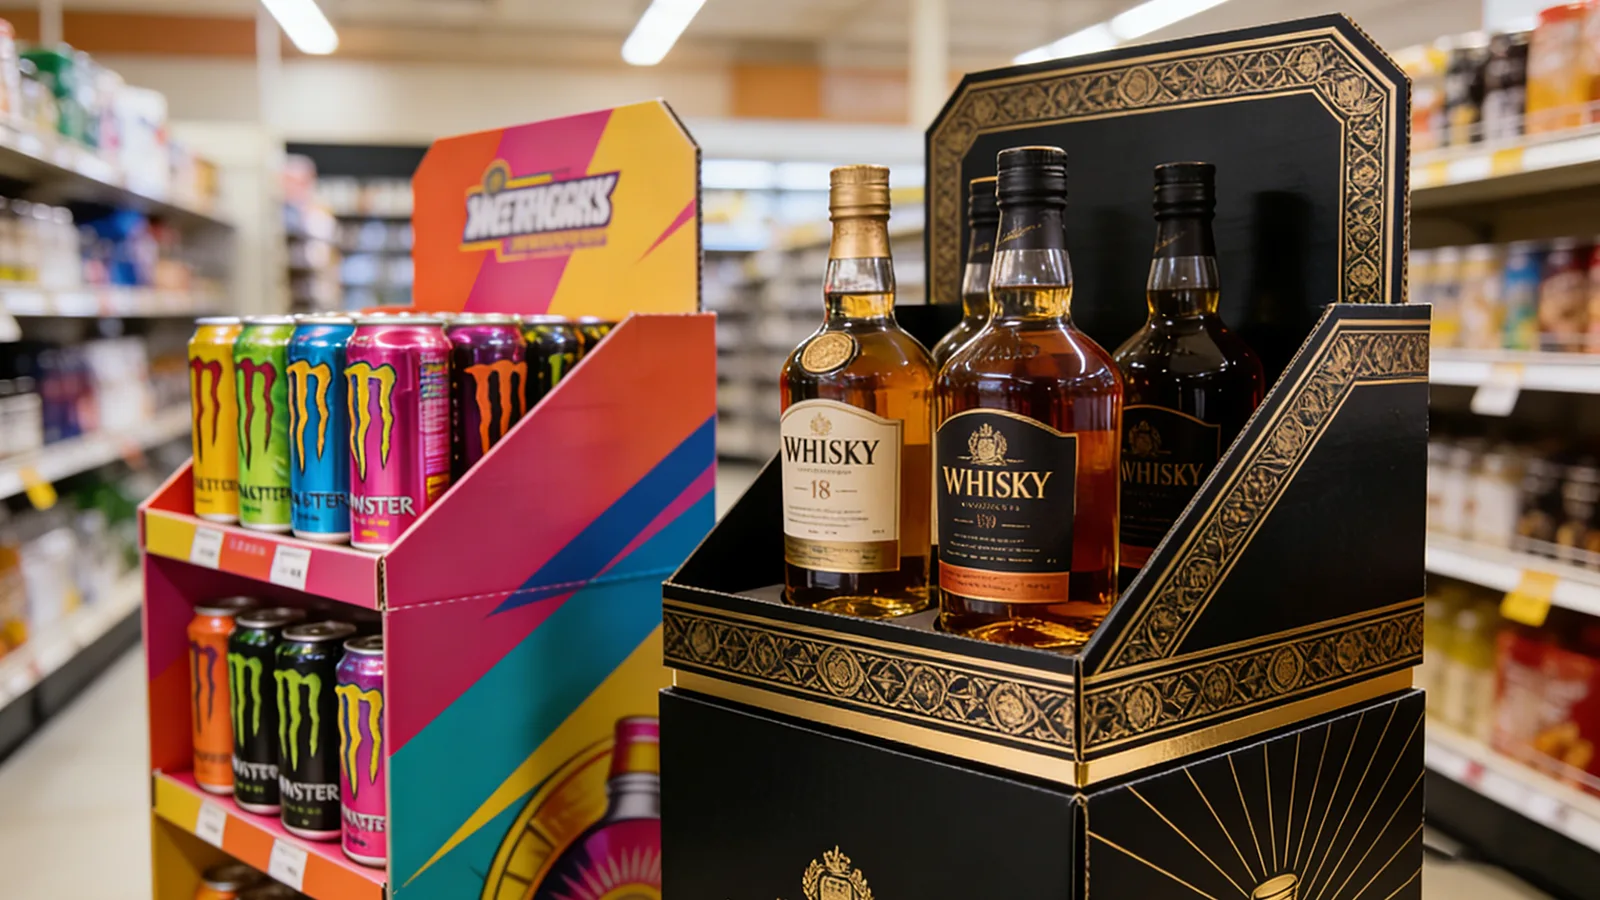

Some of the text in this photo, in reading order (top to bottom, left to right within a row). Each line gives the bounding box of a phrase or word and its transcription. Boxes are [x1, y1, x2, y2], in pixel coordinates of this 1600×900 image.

[783, 436, 880, 466] WHISKY
[942, 466, 1053, 499] WHISKY
[1121, 461, 1204, 486] WHISKY
[810, 479, 831, 500] 18
